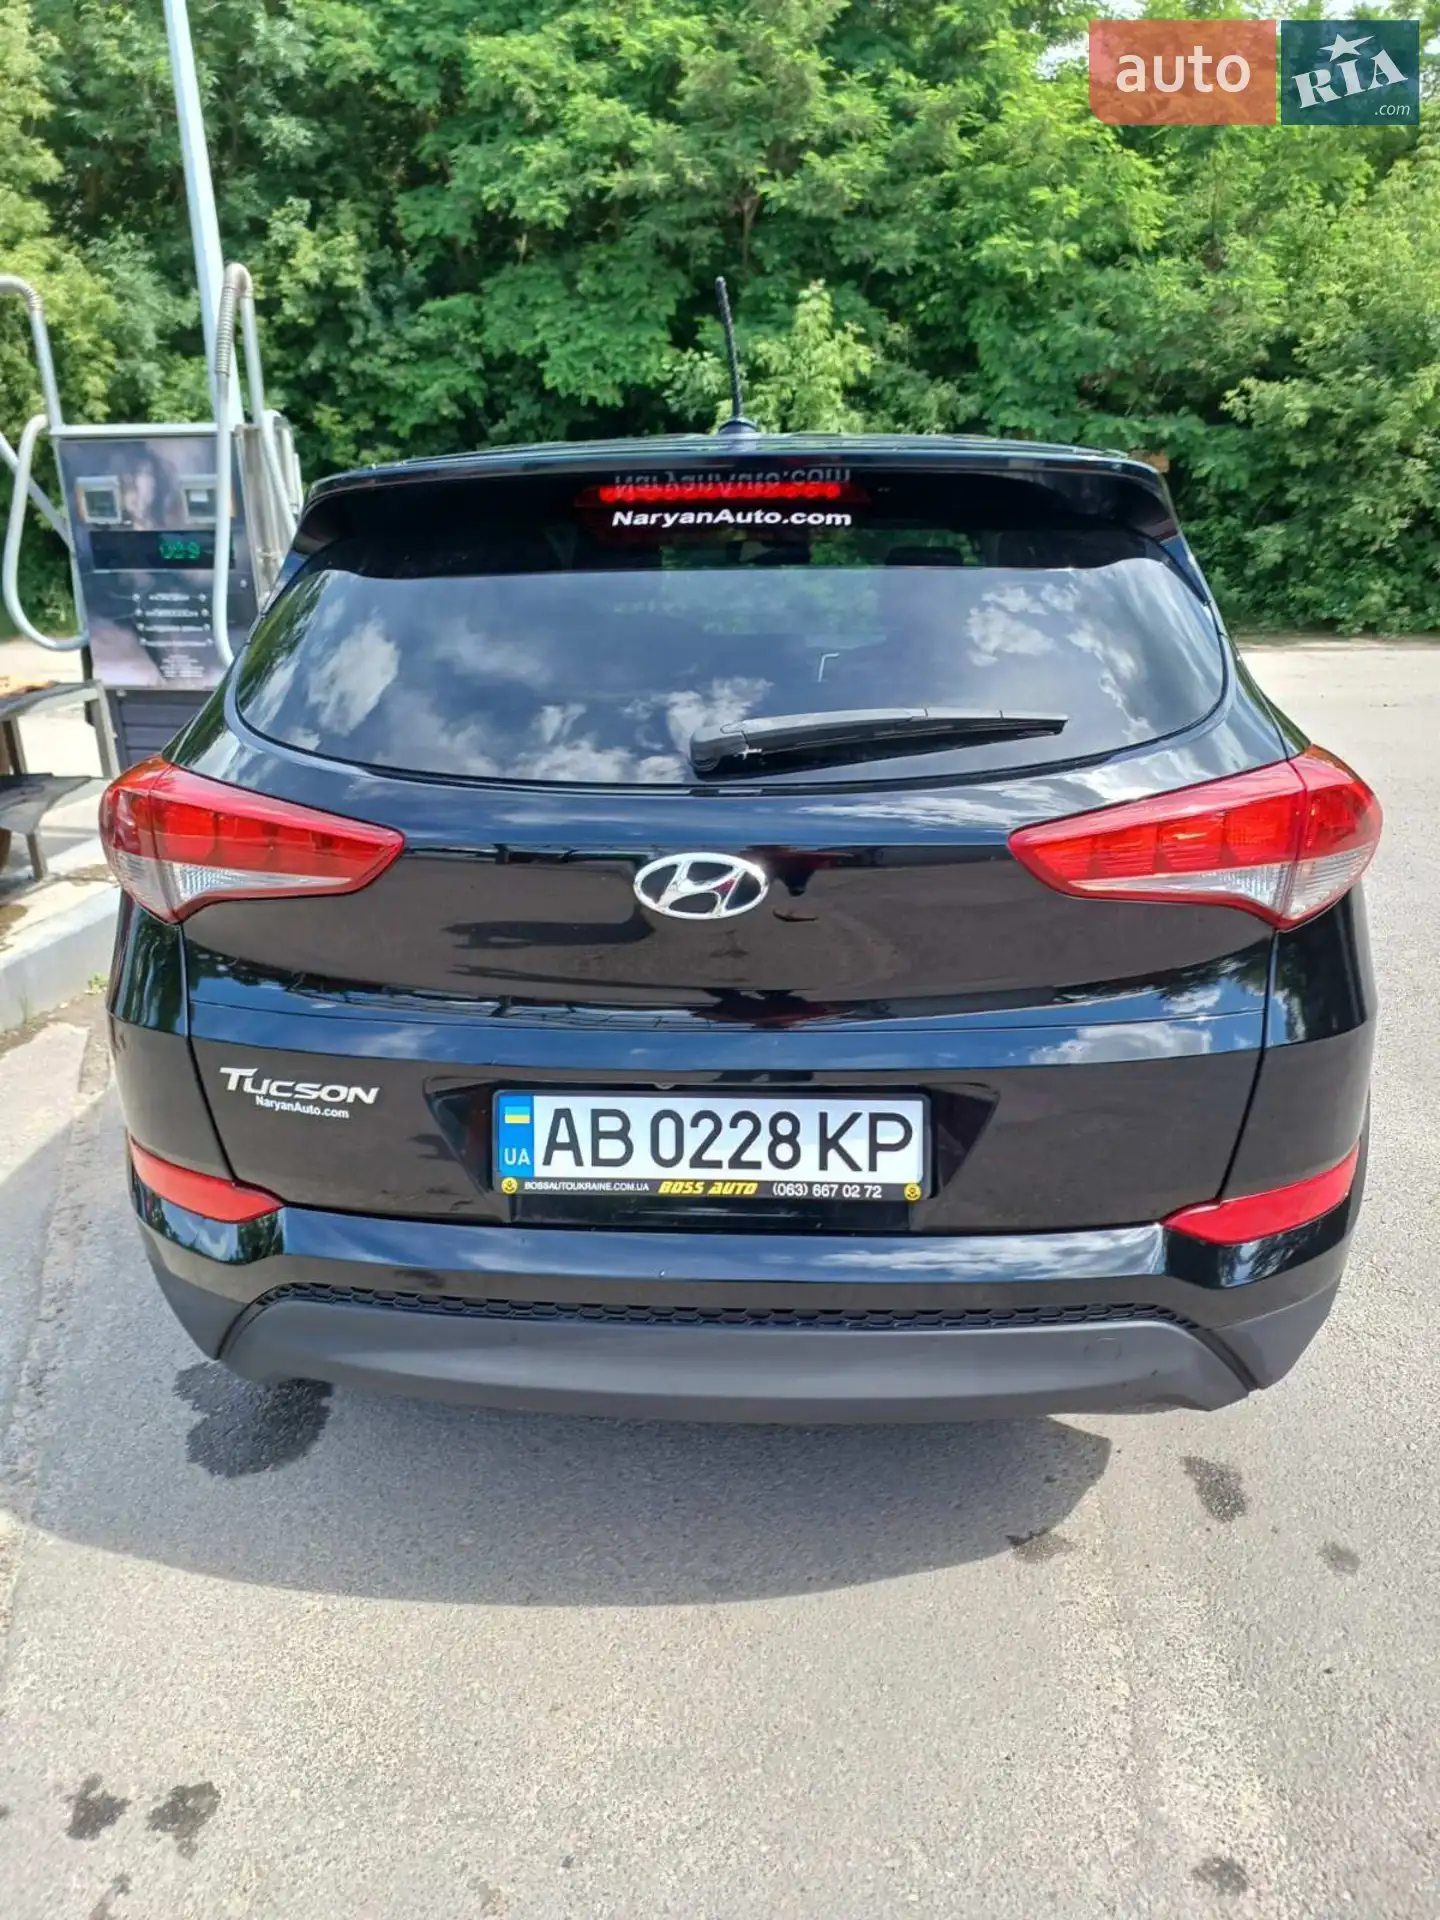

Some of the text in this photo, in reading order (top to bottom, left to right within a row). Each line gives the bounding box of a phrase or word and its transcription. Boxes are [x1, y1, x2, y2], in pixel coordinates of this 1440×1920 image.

[612, 509, 852, 528] NaryanAuto.com
[219, 1067, 380, 1104] TUCSON
[255, 1095, 350, 1118] NaryanAuto.com
[541, 1107, 914, 1172] AB 0228 KP
[503, 1148, 531, 1165] UA
[523, 1181, 650, 1192] BOSSAUTOUKRAINE.COM.UA
[657, 1181, 759, 1196] BOSS AUTO
[771, 1183, 883, 1199] (063) 667 02 72
